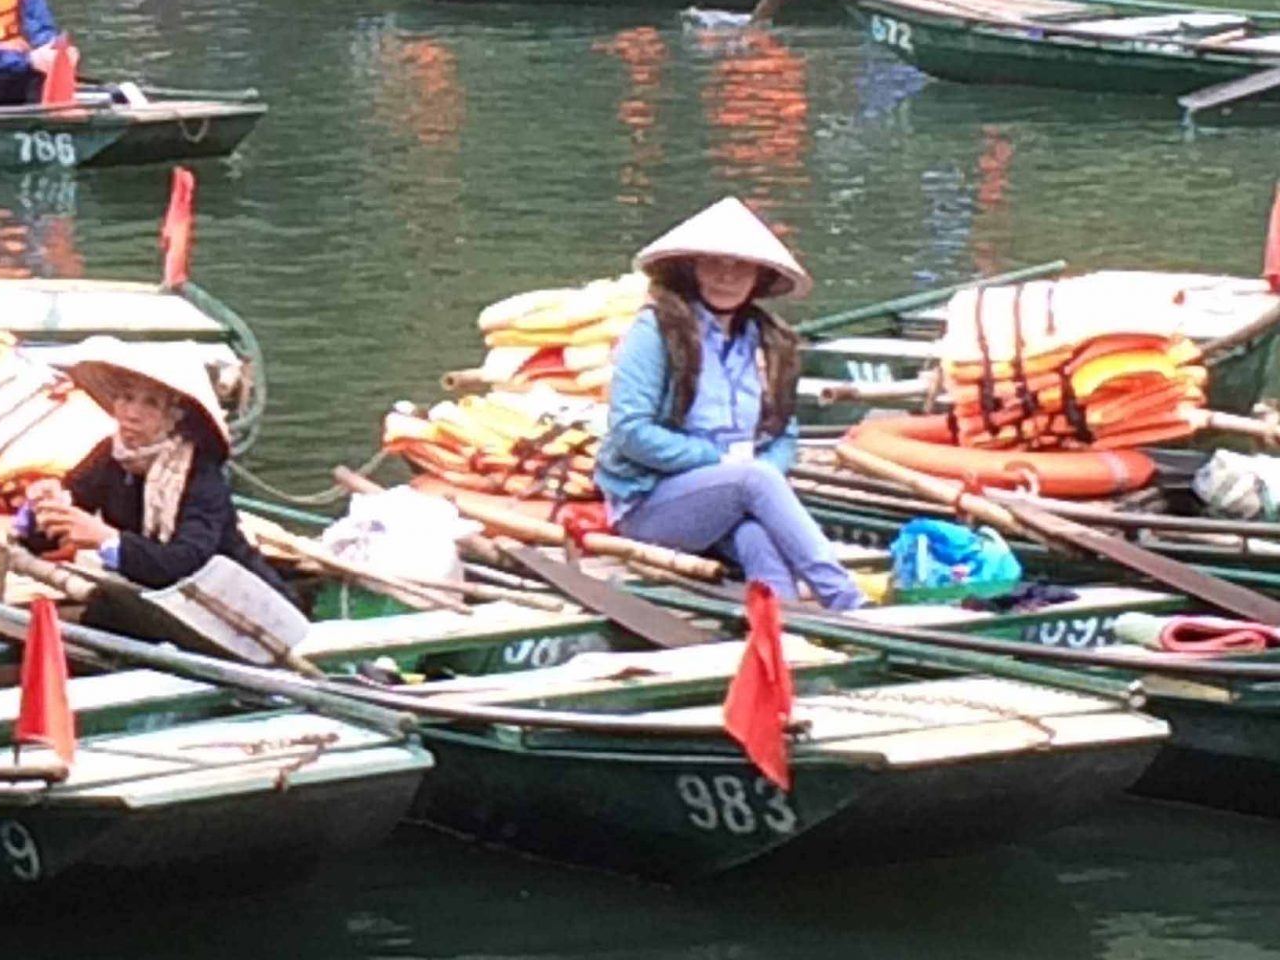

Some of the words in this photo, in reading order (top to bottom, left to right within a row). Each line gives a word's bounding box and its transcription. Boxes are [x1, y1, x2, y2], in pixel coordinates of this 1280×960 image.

[872, 14, 914, 54] 672
[14, 130, 76, 166] 786
[677, 774, 797, 833] 983
